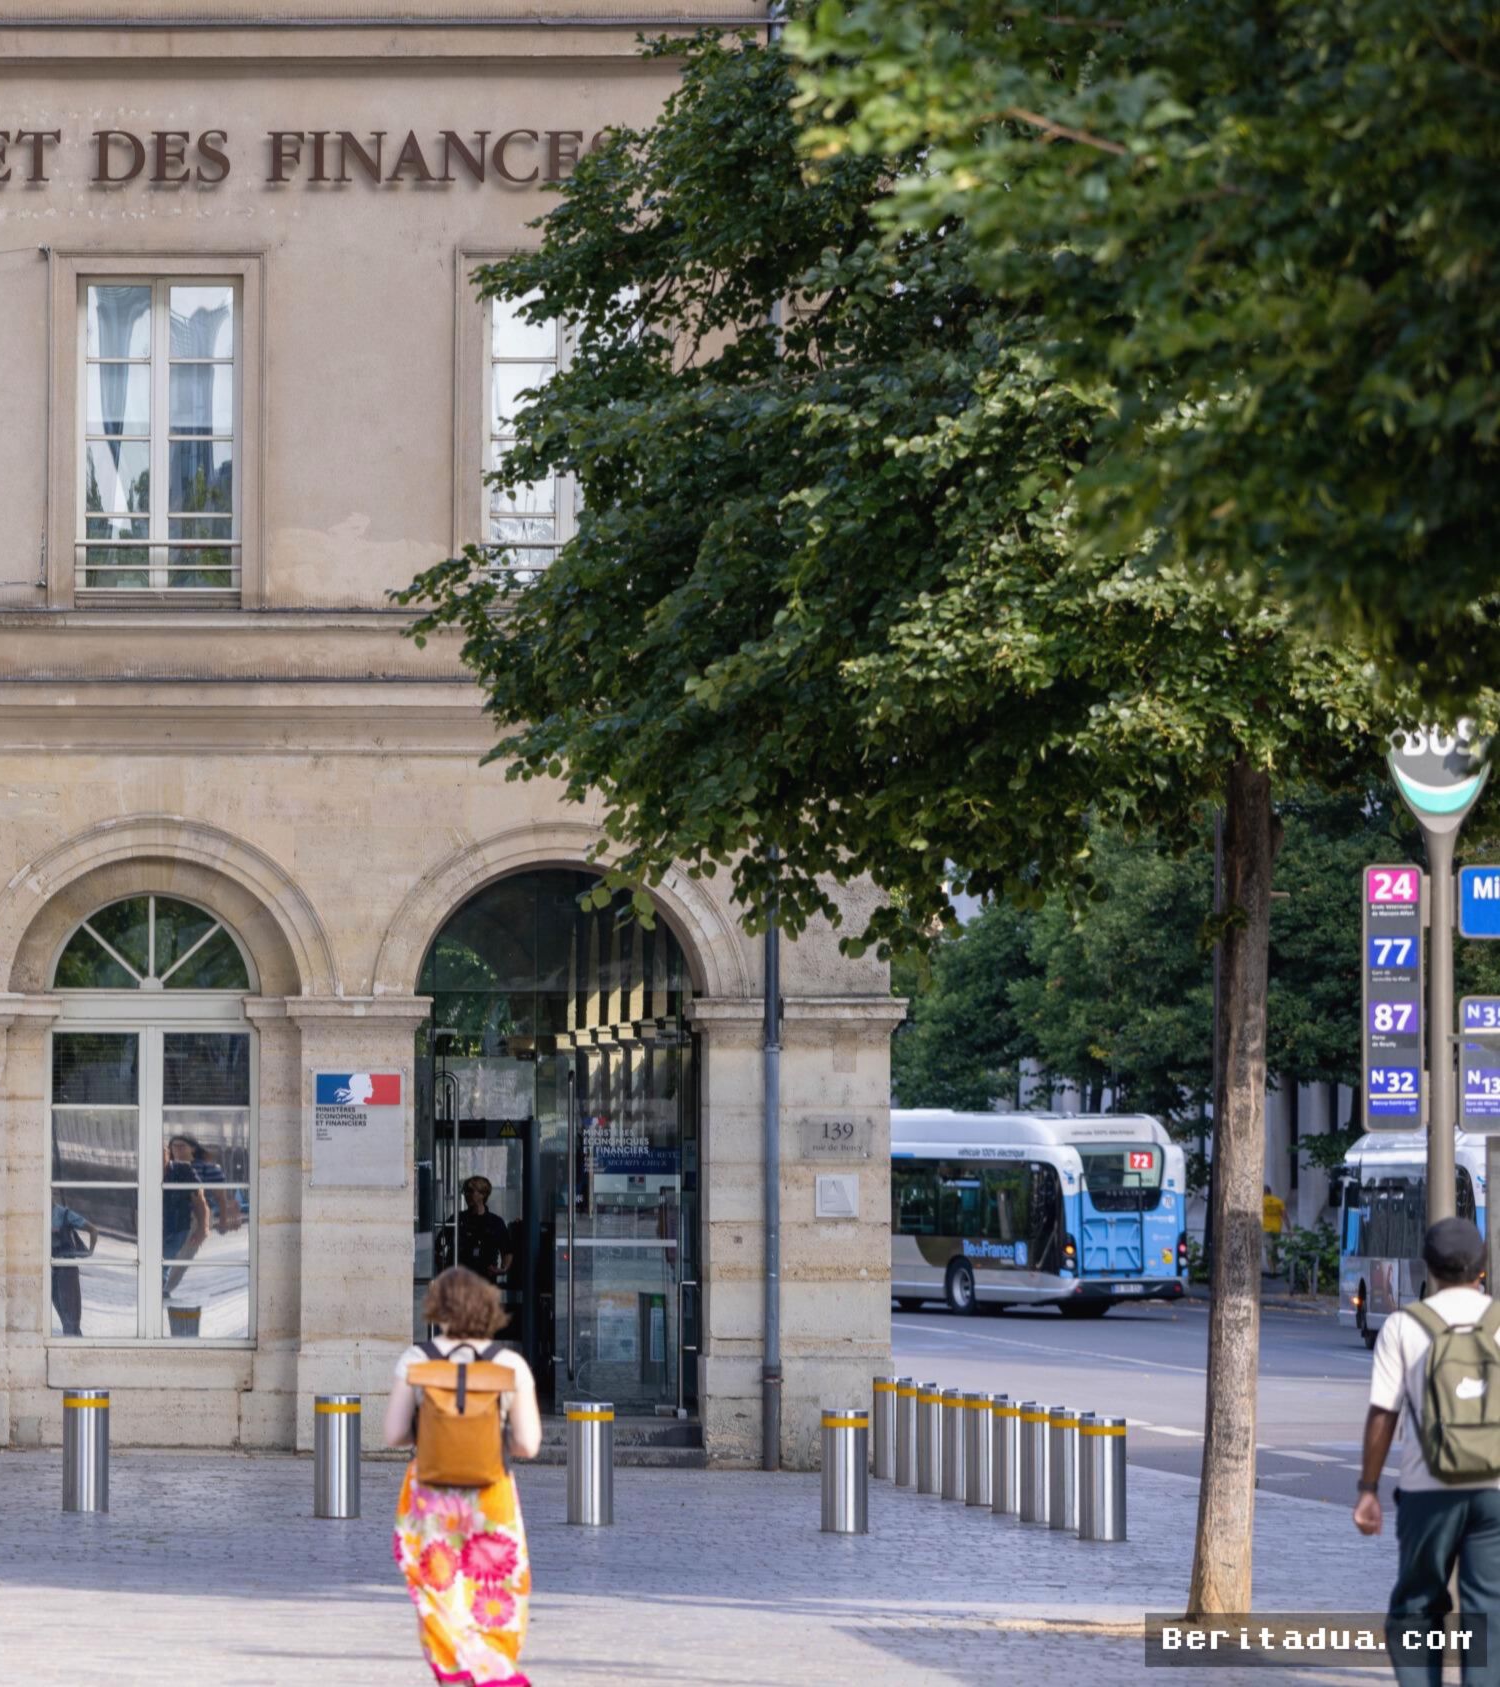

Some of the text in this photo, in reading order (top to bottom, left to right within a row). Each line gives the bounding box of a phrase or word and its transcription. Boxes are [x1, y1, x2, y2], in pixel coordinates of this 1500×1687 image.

[90, 129, 230, 183] DES
[1373, 873, 1414, 900] 24
[1373, 938, 1412, 965] 77
[1374, 1004, 1412, 1031] 87
[822, 1122, 854, 1140] 139
[1133, 1154, 1149, 1168] 72
